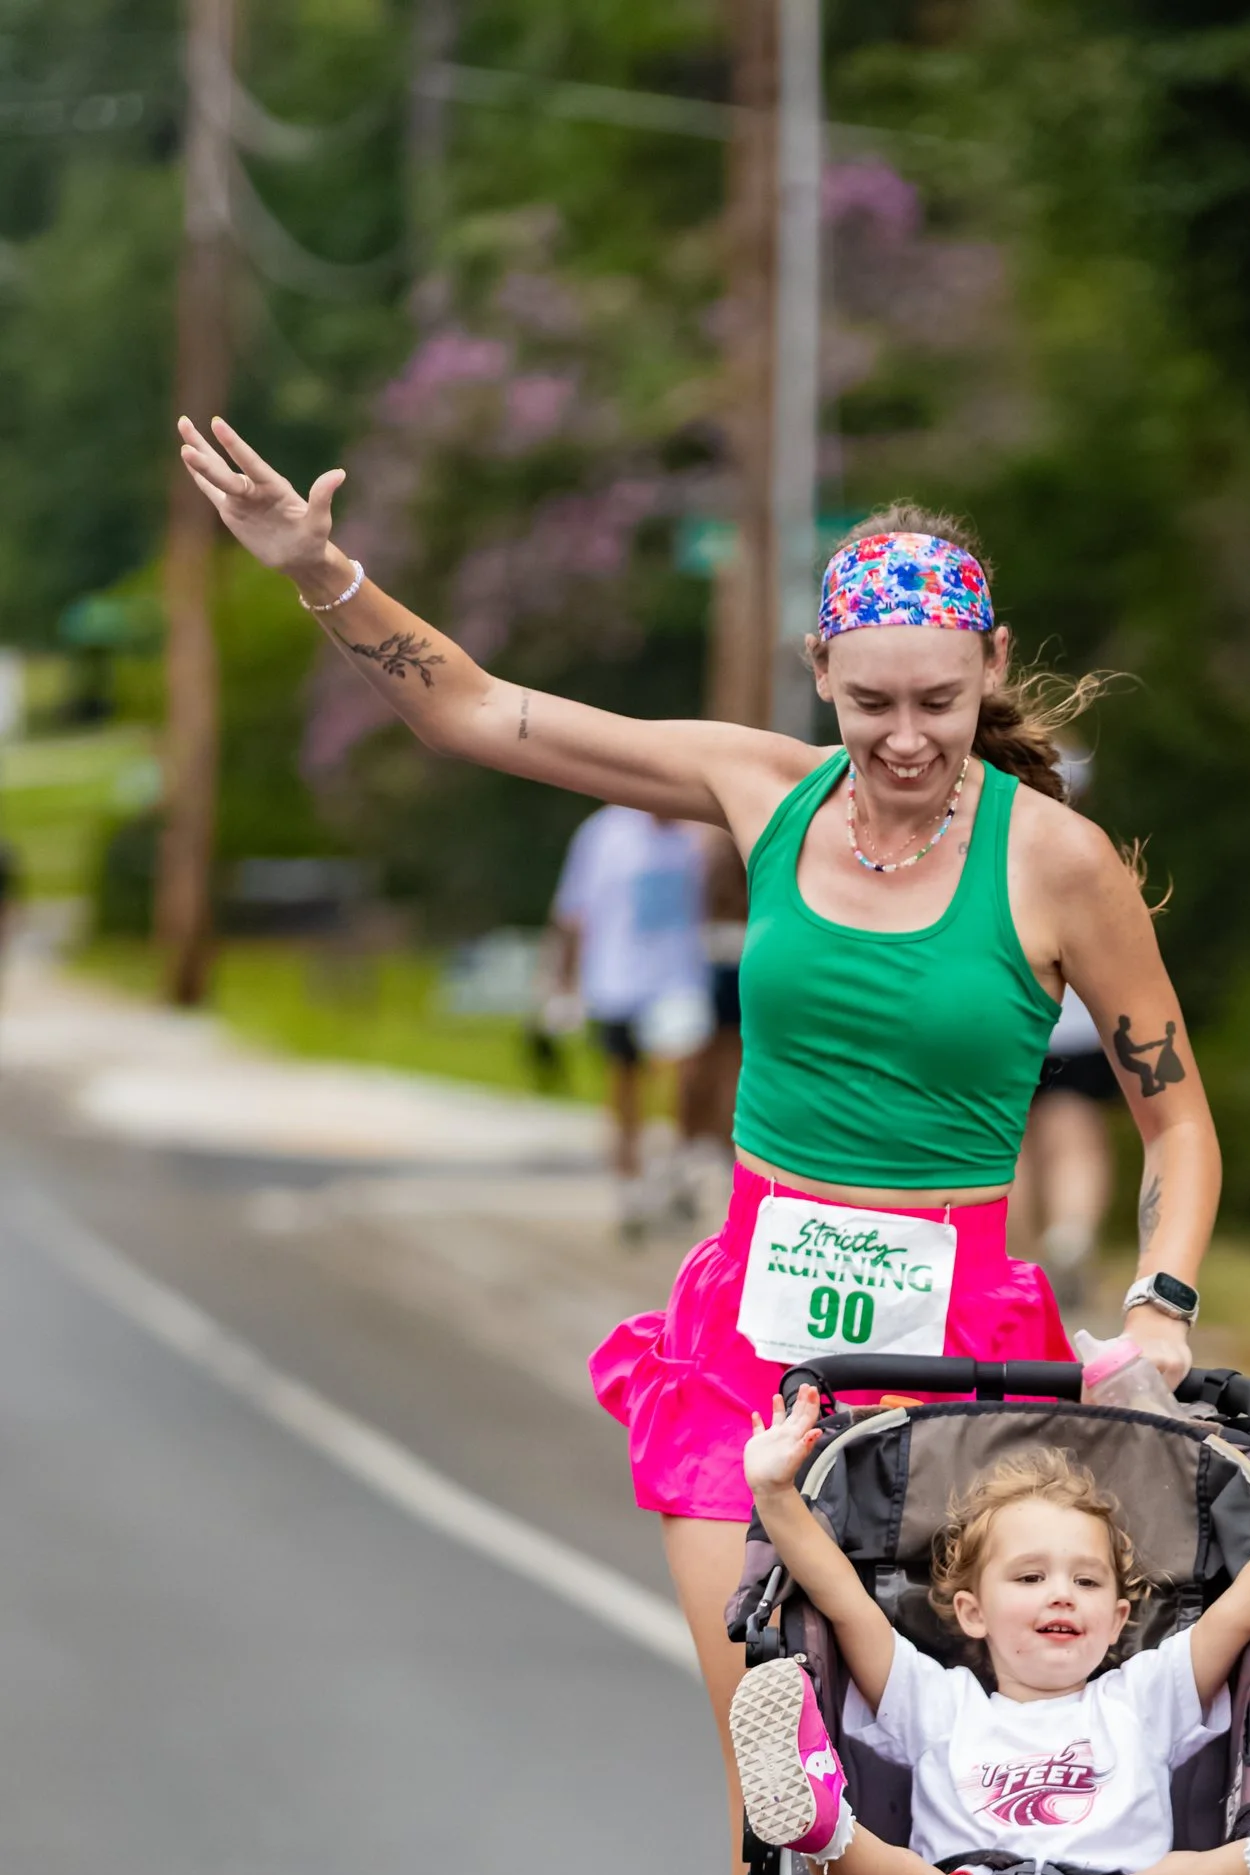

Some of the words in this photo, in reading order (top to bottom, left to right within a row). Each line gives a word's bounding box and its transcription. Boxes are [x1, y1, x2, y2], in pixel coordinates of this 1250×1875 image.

[797, 1219, 908, 1267] Strictly
[767, 1243, 933, 1293] RUNNING
[807, 1286, 876, 1345] 90
[1000, 1764, 1088, 1797] FEET
